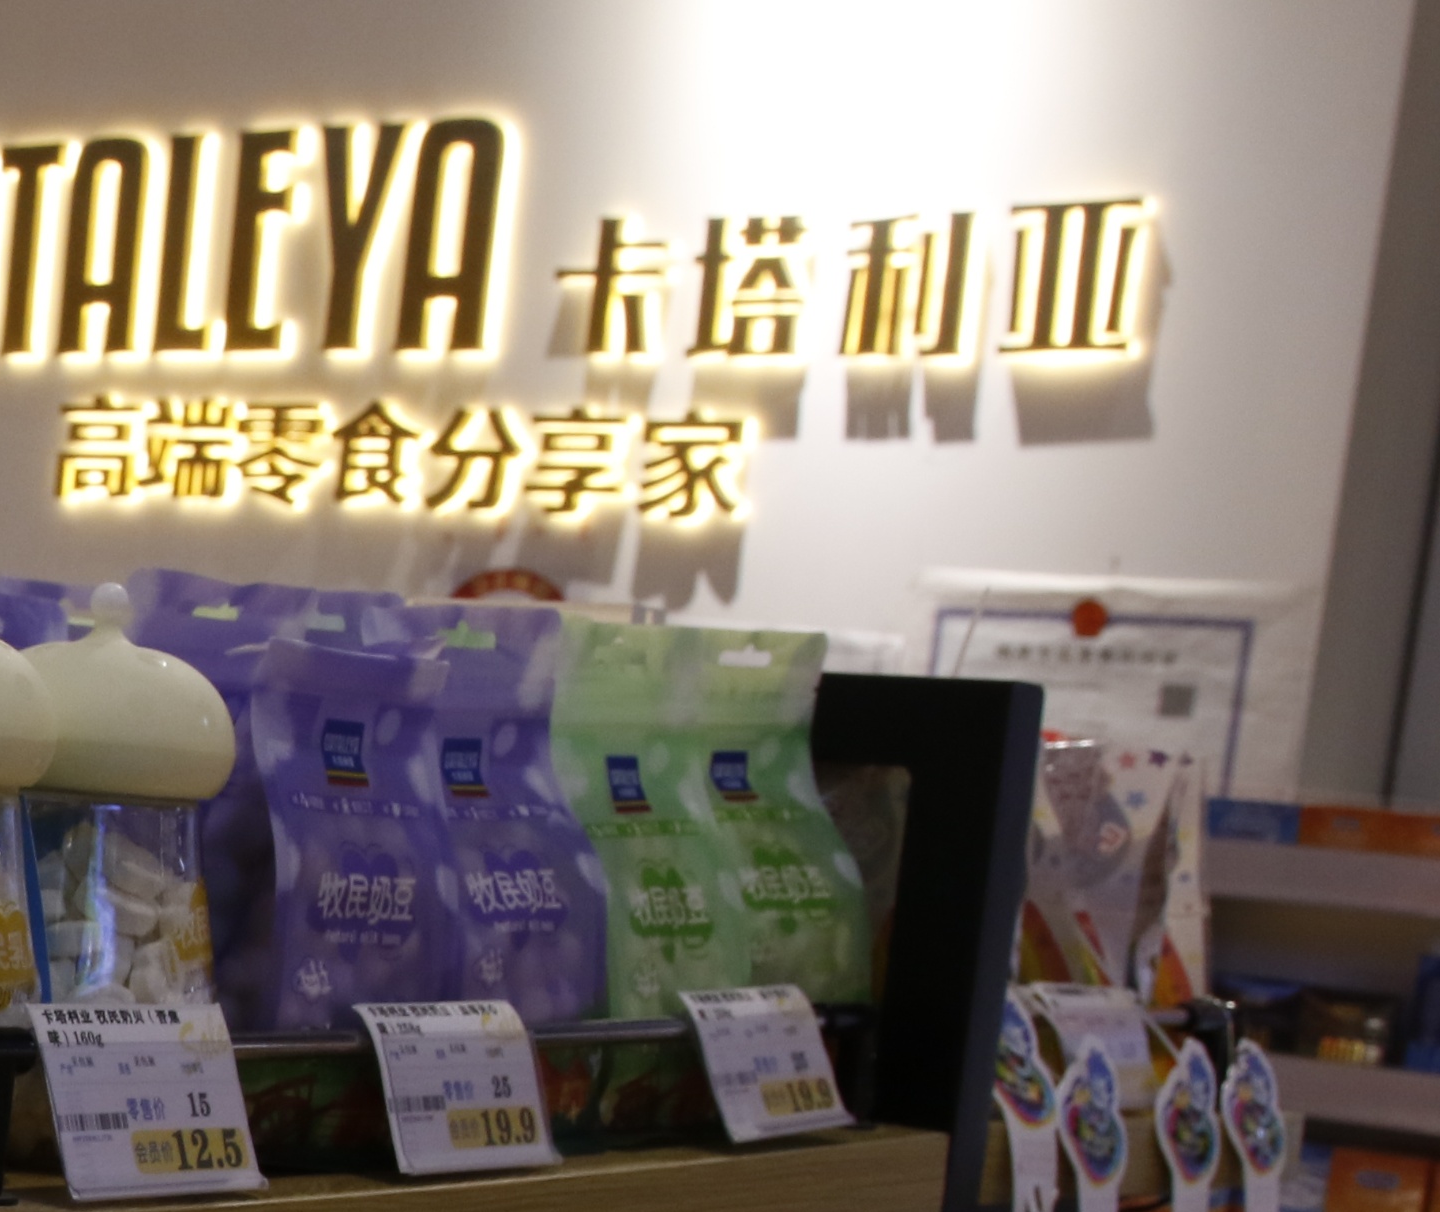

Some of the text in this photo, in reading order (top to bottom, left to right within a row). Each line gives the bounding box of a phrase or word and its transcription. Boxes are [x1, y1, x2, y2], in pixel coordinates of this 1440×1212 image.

[555, 198, 1146, 355] 卡塔利亚
[57, 396, 745, 518] 高端零食分享家
[318, 871, 417, 925] 牧民奶豆
[187, 1092, 211, 1118] 15
[481, 1106, 536, 1147] 19.9
[172, 1128, 243, 1171] 12.5
